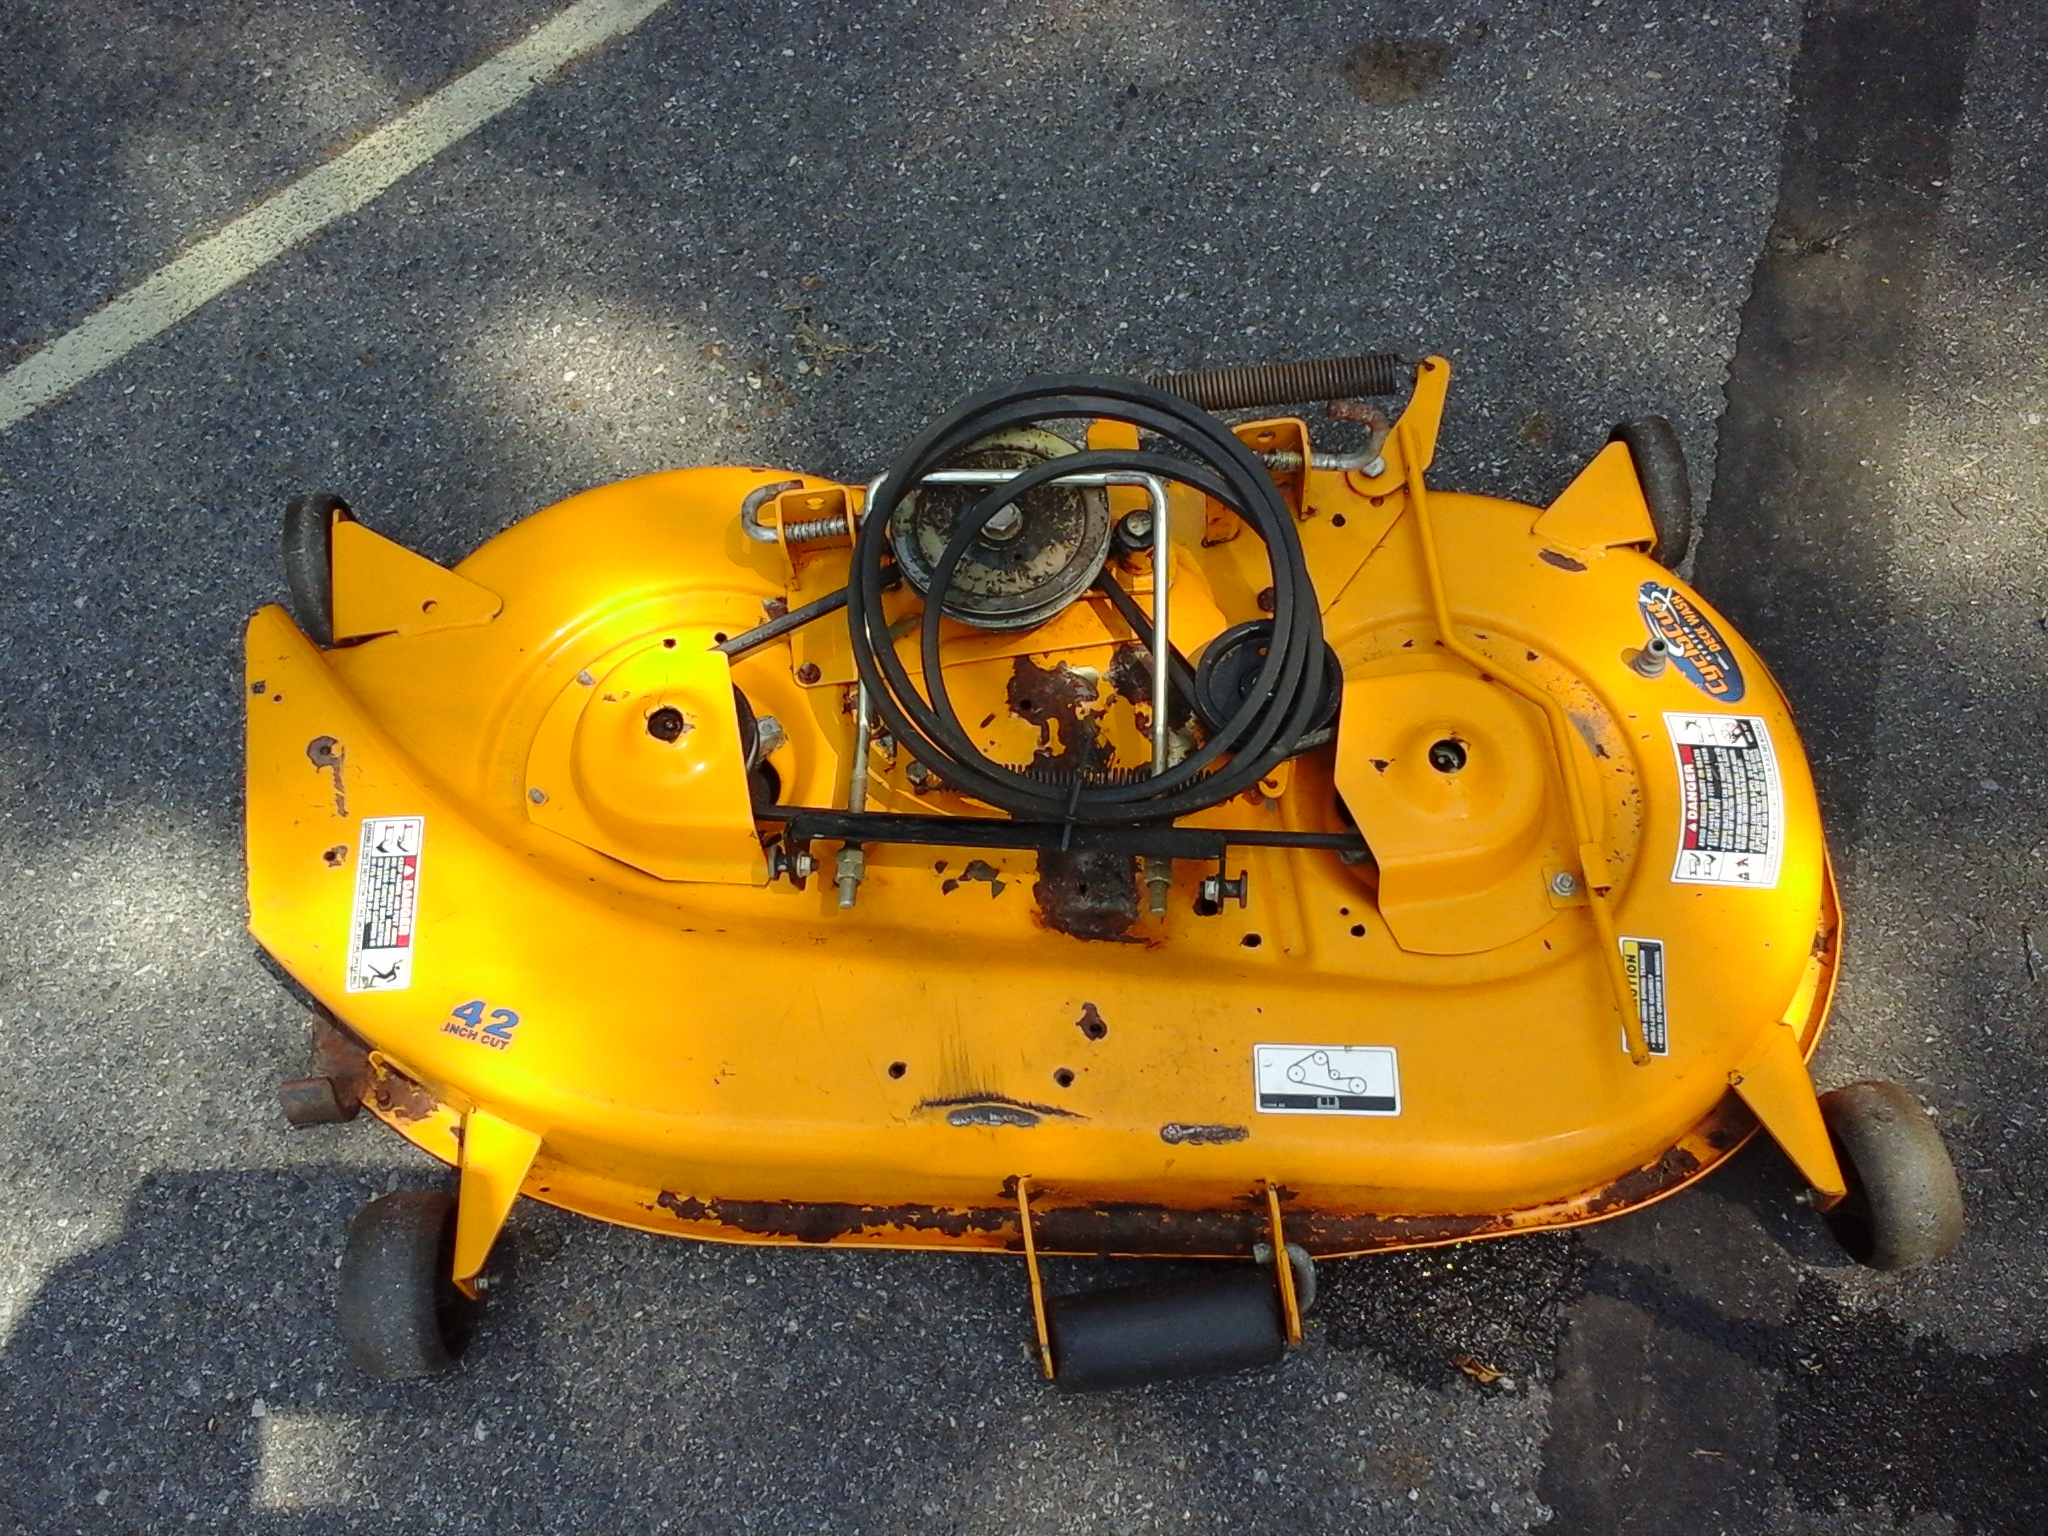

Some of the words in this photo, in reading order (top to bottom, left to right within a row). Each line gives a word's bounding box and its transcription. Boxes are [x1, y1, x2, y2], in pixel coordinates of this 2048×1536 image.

[1670, 594, 1700, 627] WASH
[1693, 625, 1722, 653] DECK
[1683, 763, 1697, 819] DANGER
[397, 879, 412, 936] DANGER
[440, 1022, 478, 1040] INCH
[481, 1035, 509, 1050] CUT
[452, 1001, 519, 1039] 42
